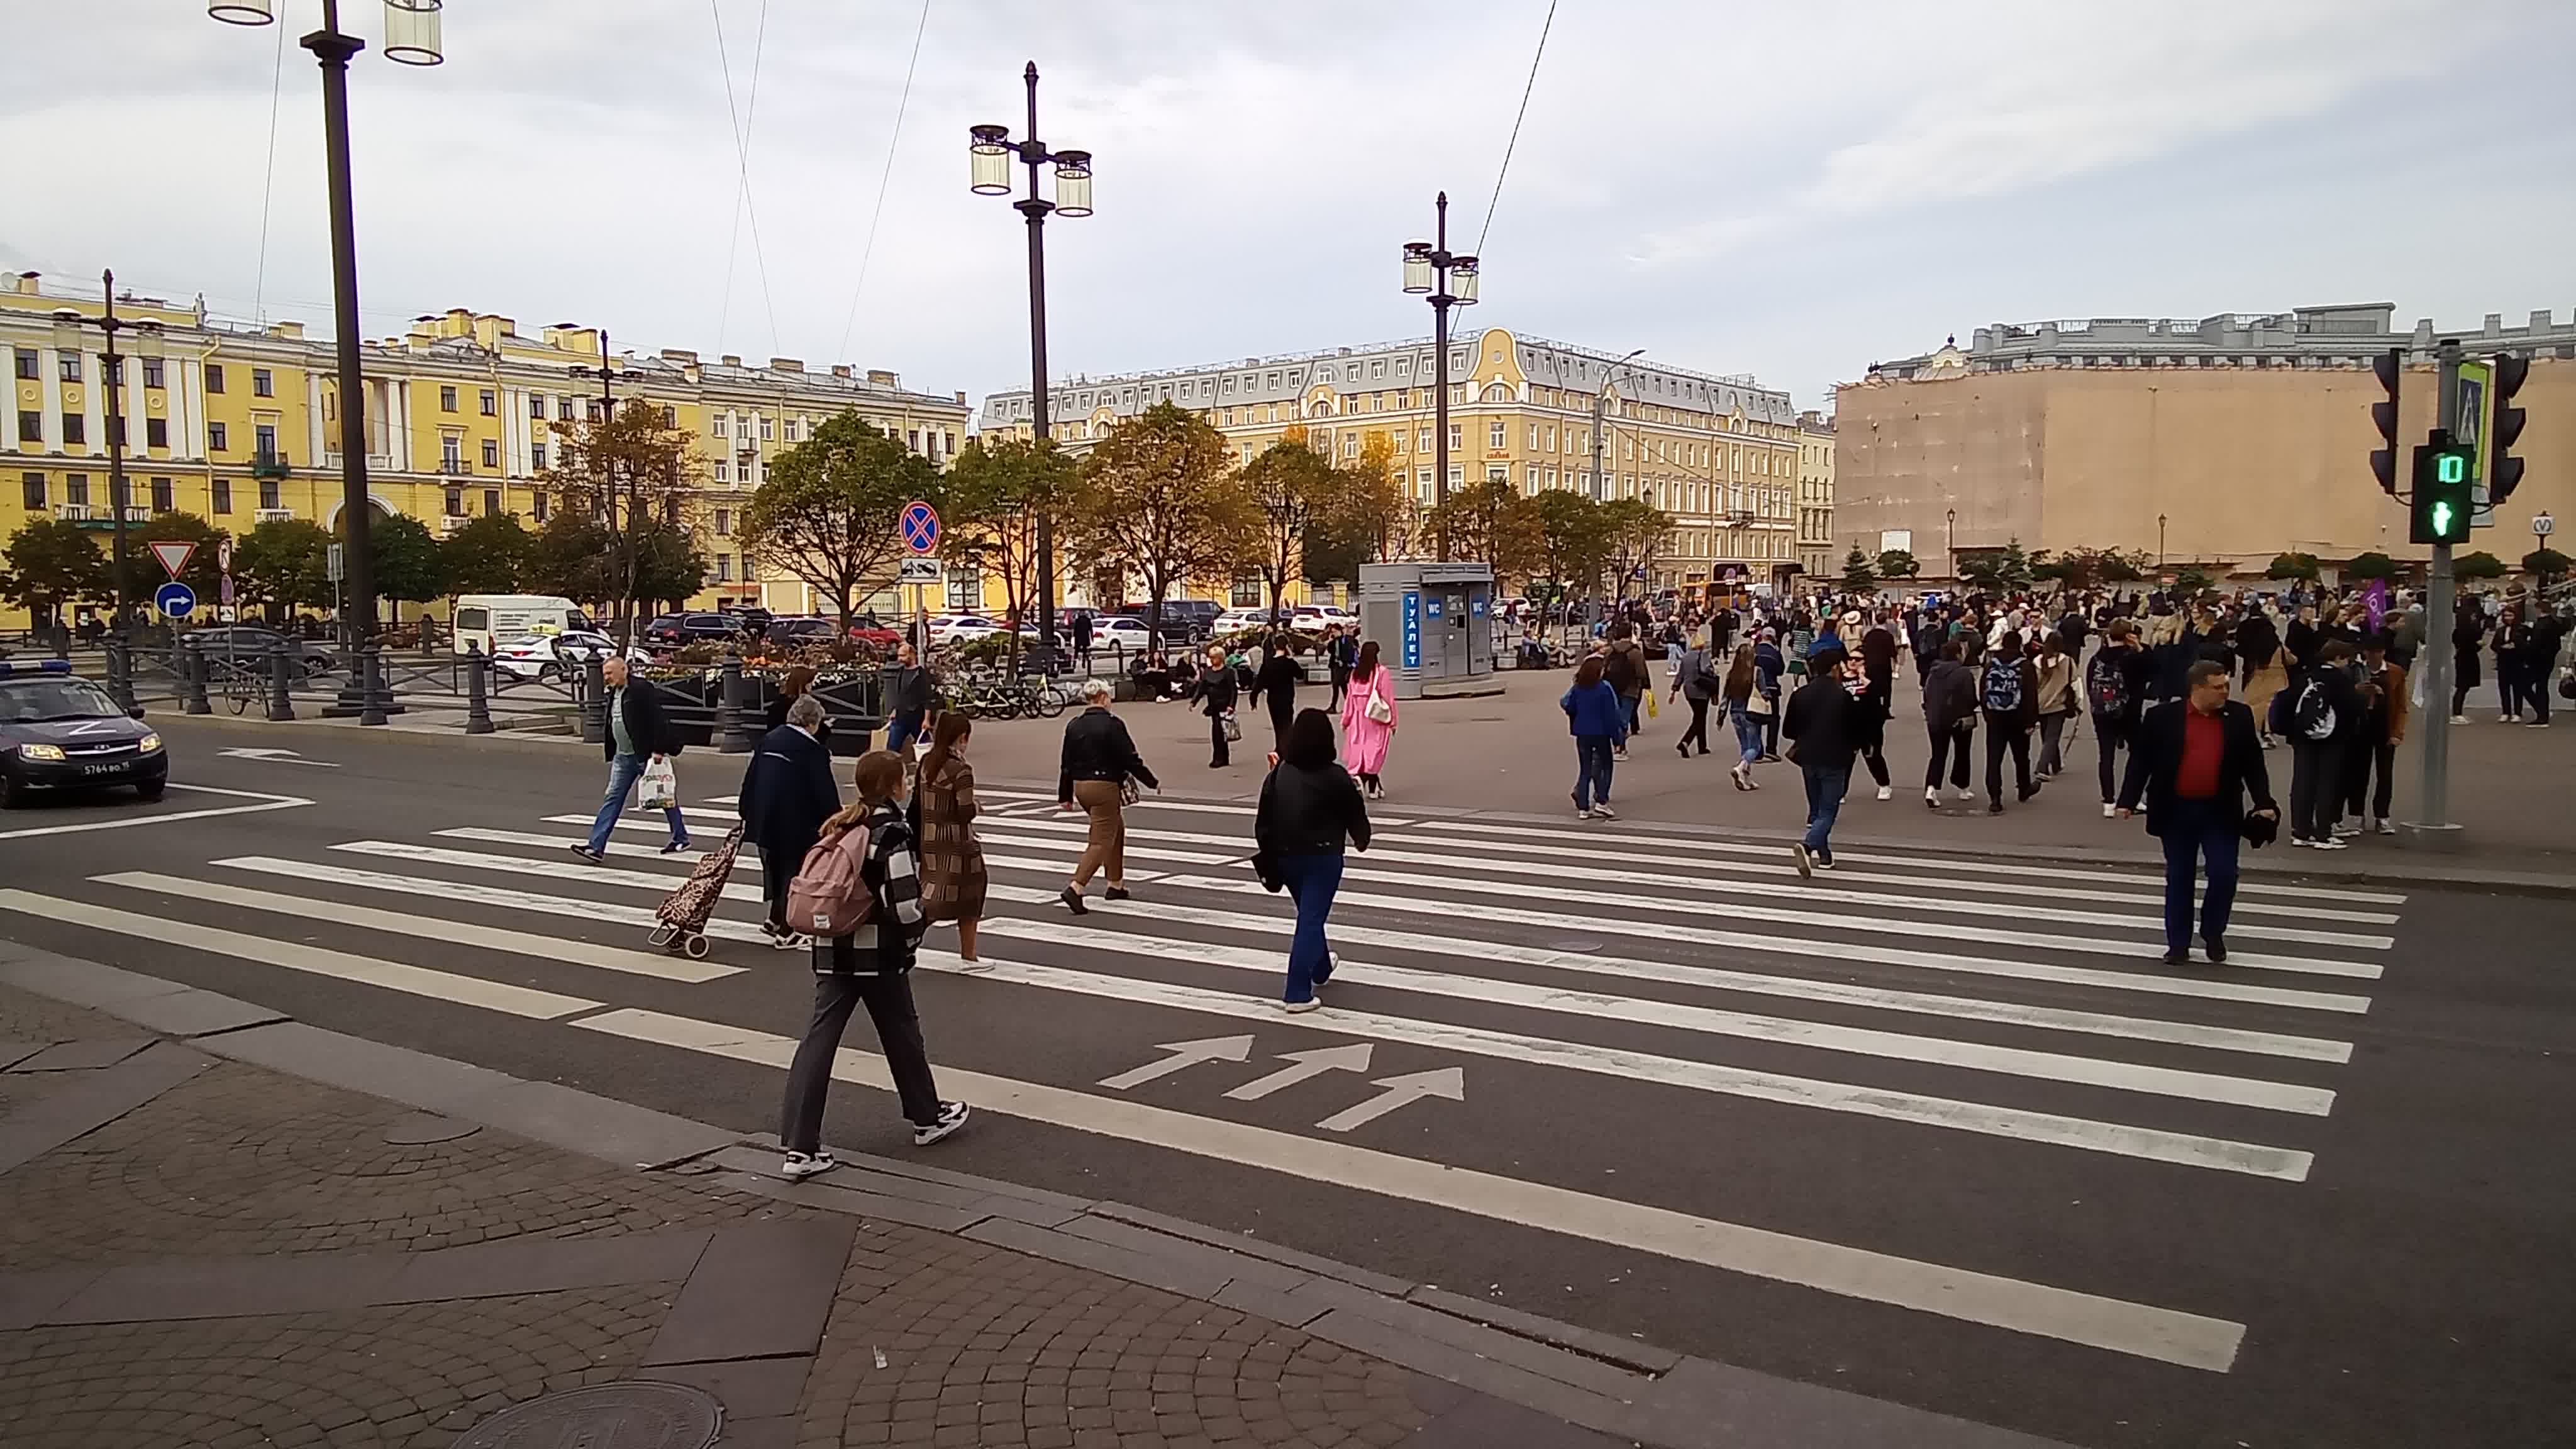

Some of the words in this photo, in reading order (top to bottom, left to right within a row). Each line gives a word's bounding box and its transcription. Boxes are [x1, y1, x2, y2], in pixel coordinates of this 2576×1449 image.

[1427, 603, 1440, 614] WC
[1472, 602, 1482, 613] WC
[1407, 596, 1417, 665] ТУАЛЕТ
